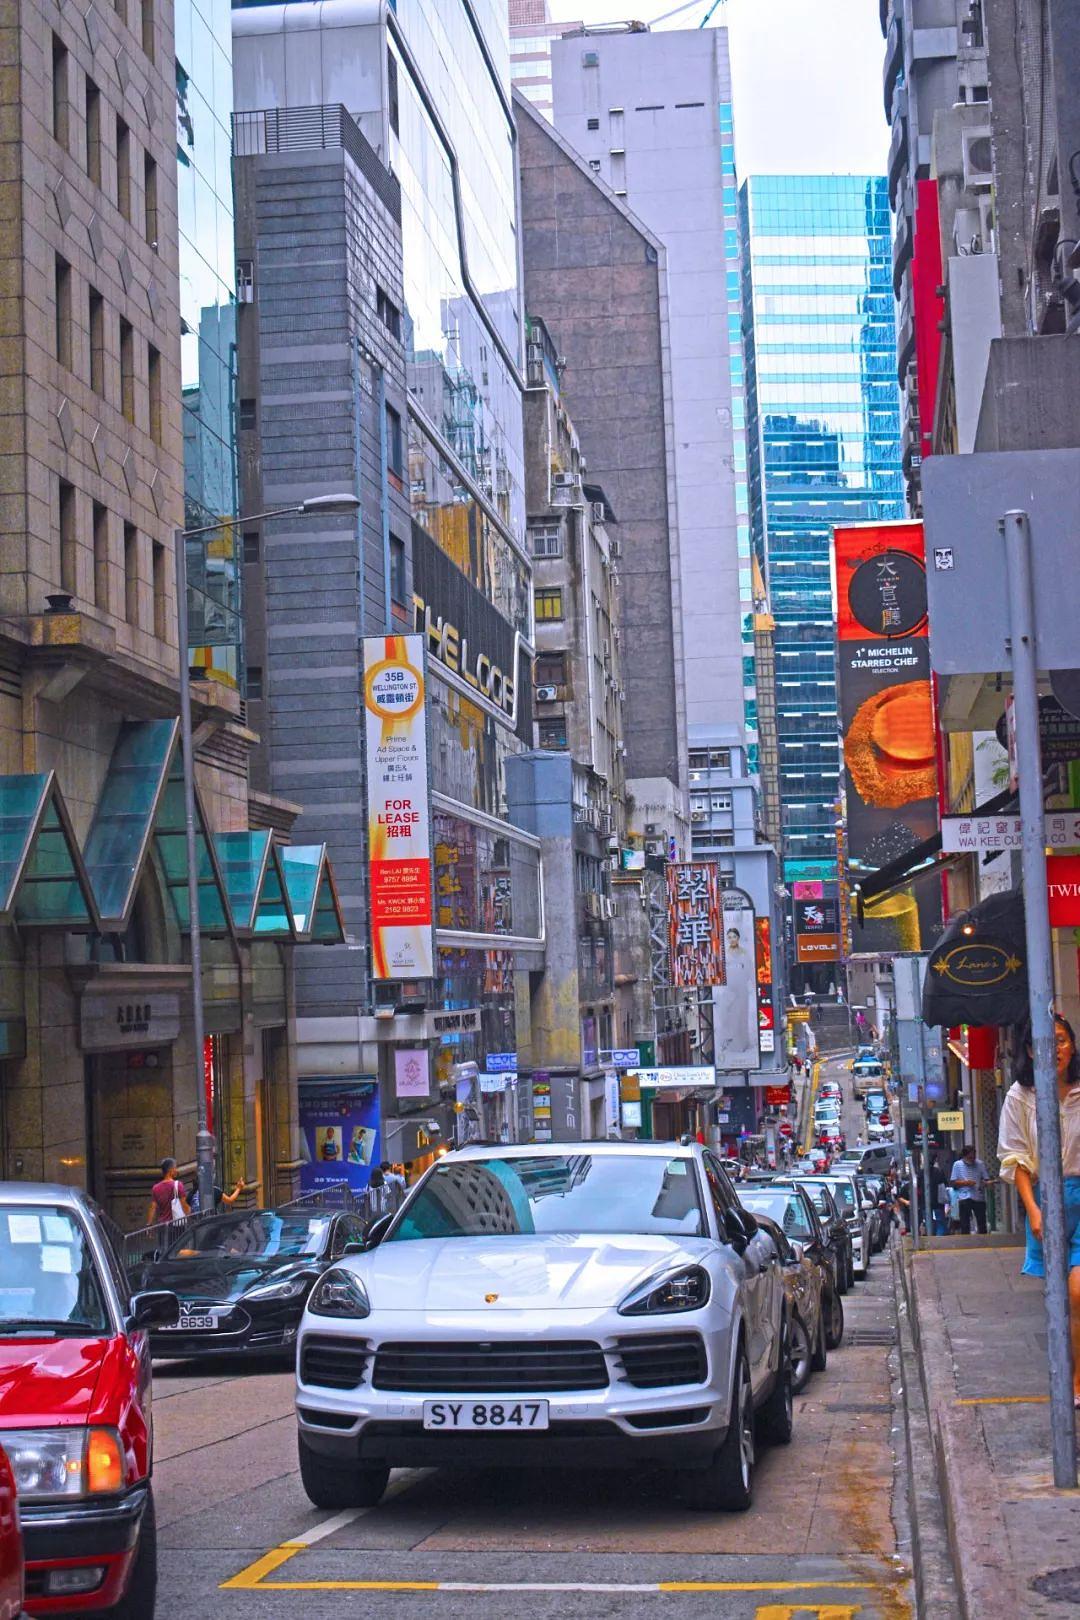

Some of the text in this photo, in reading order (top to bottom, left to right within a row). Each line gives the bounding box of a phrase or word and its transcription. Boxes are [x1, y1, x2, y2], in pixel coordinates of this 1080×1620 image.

[867, 647, 913, 657] MICHELIN
[851, 657, 919, 669] STARRED CHEF
[384, 672, 404, 681] 35B
[373, 683, 409, 691] WELLINGTON
[385, 799, 412, 810] FOR
[378, 812, 420, 824] LEASE
[387, 825, 412, 838] 招租
[959, 837, 977, 847] WAI
[980, 836, 1001, 846] KEE
[678, 869, 712, 948] 翠華
[181, 1316, 213, 1328] 6639
[431, 1404, 540, 1425] SY 8847
